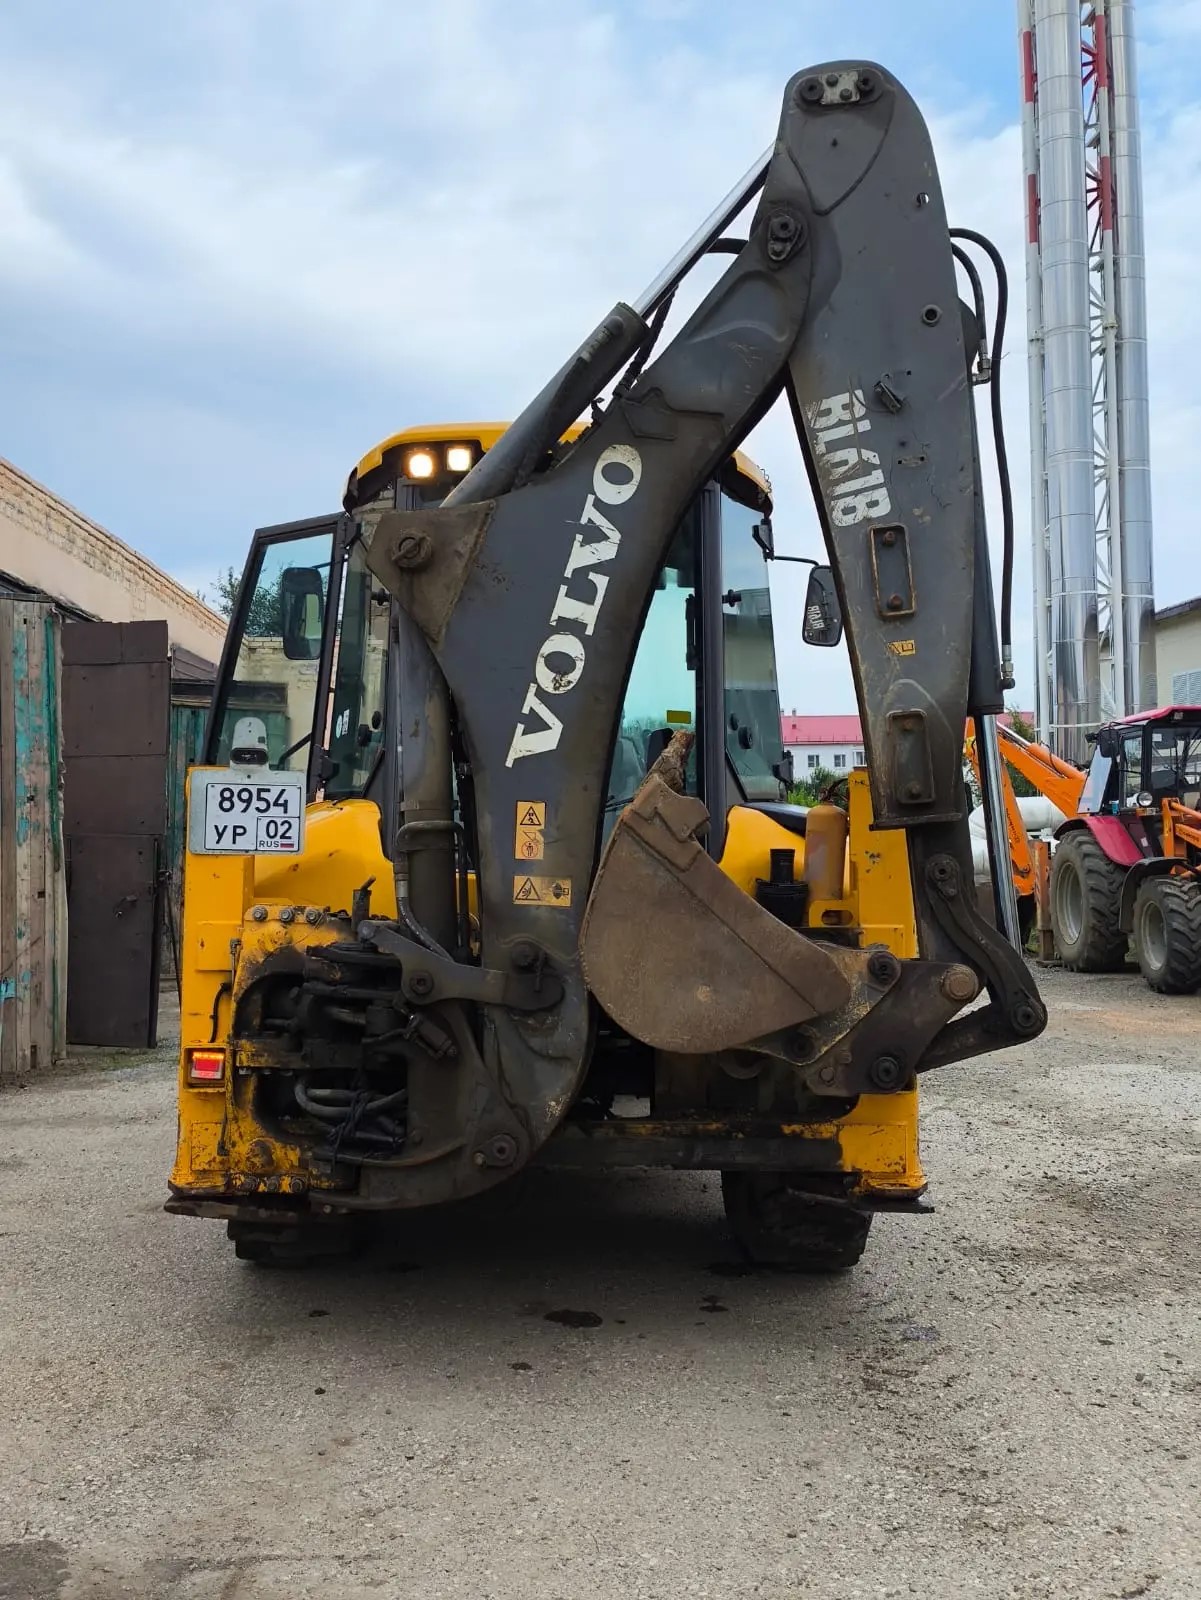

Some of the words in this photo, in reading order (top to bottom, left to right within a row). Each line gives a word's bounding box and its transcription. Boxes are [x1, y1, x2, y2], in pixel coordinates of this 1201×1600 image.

[806, 389, 892, 527] BL61B
[505, 444, 643, 768] VOLVO
[218, 787, 289, 815] 8954
[265, 819, 293, 840] 02
[258, 840, 280, 848] RUS
